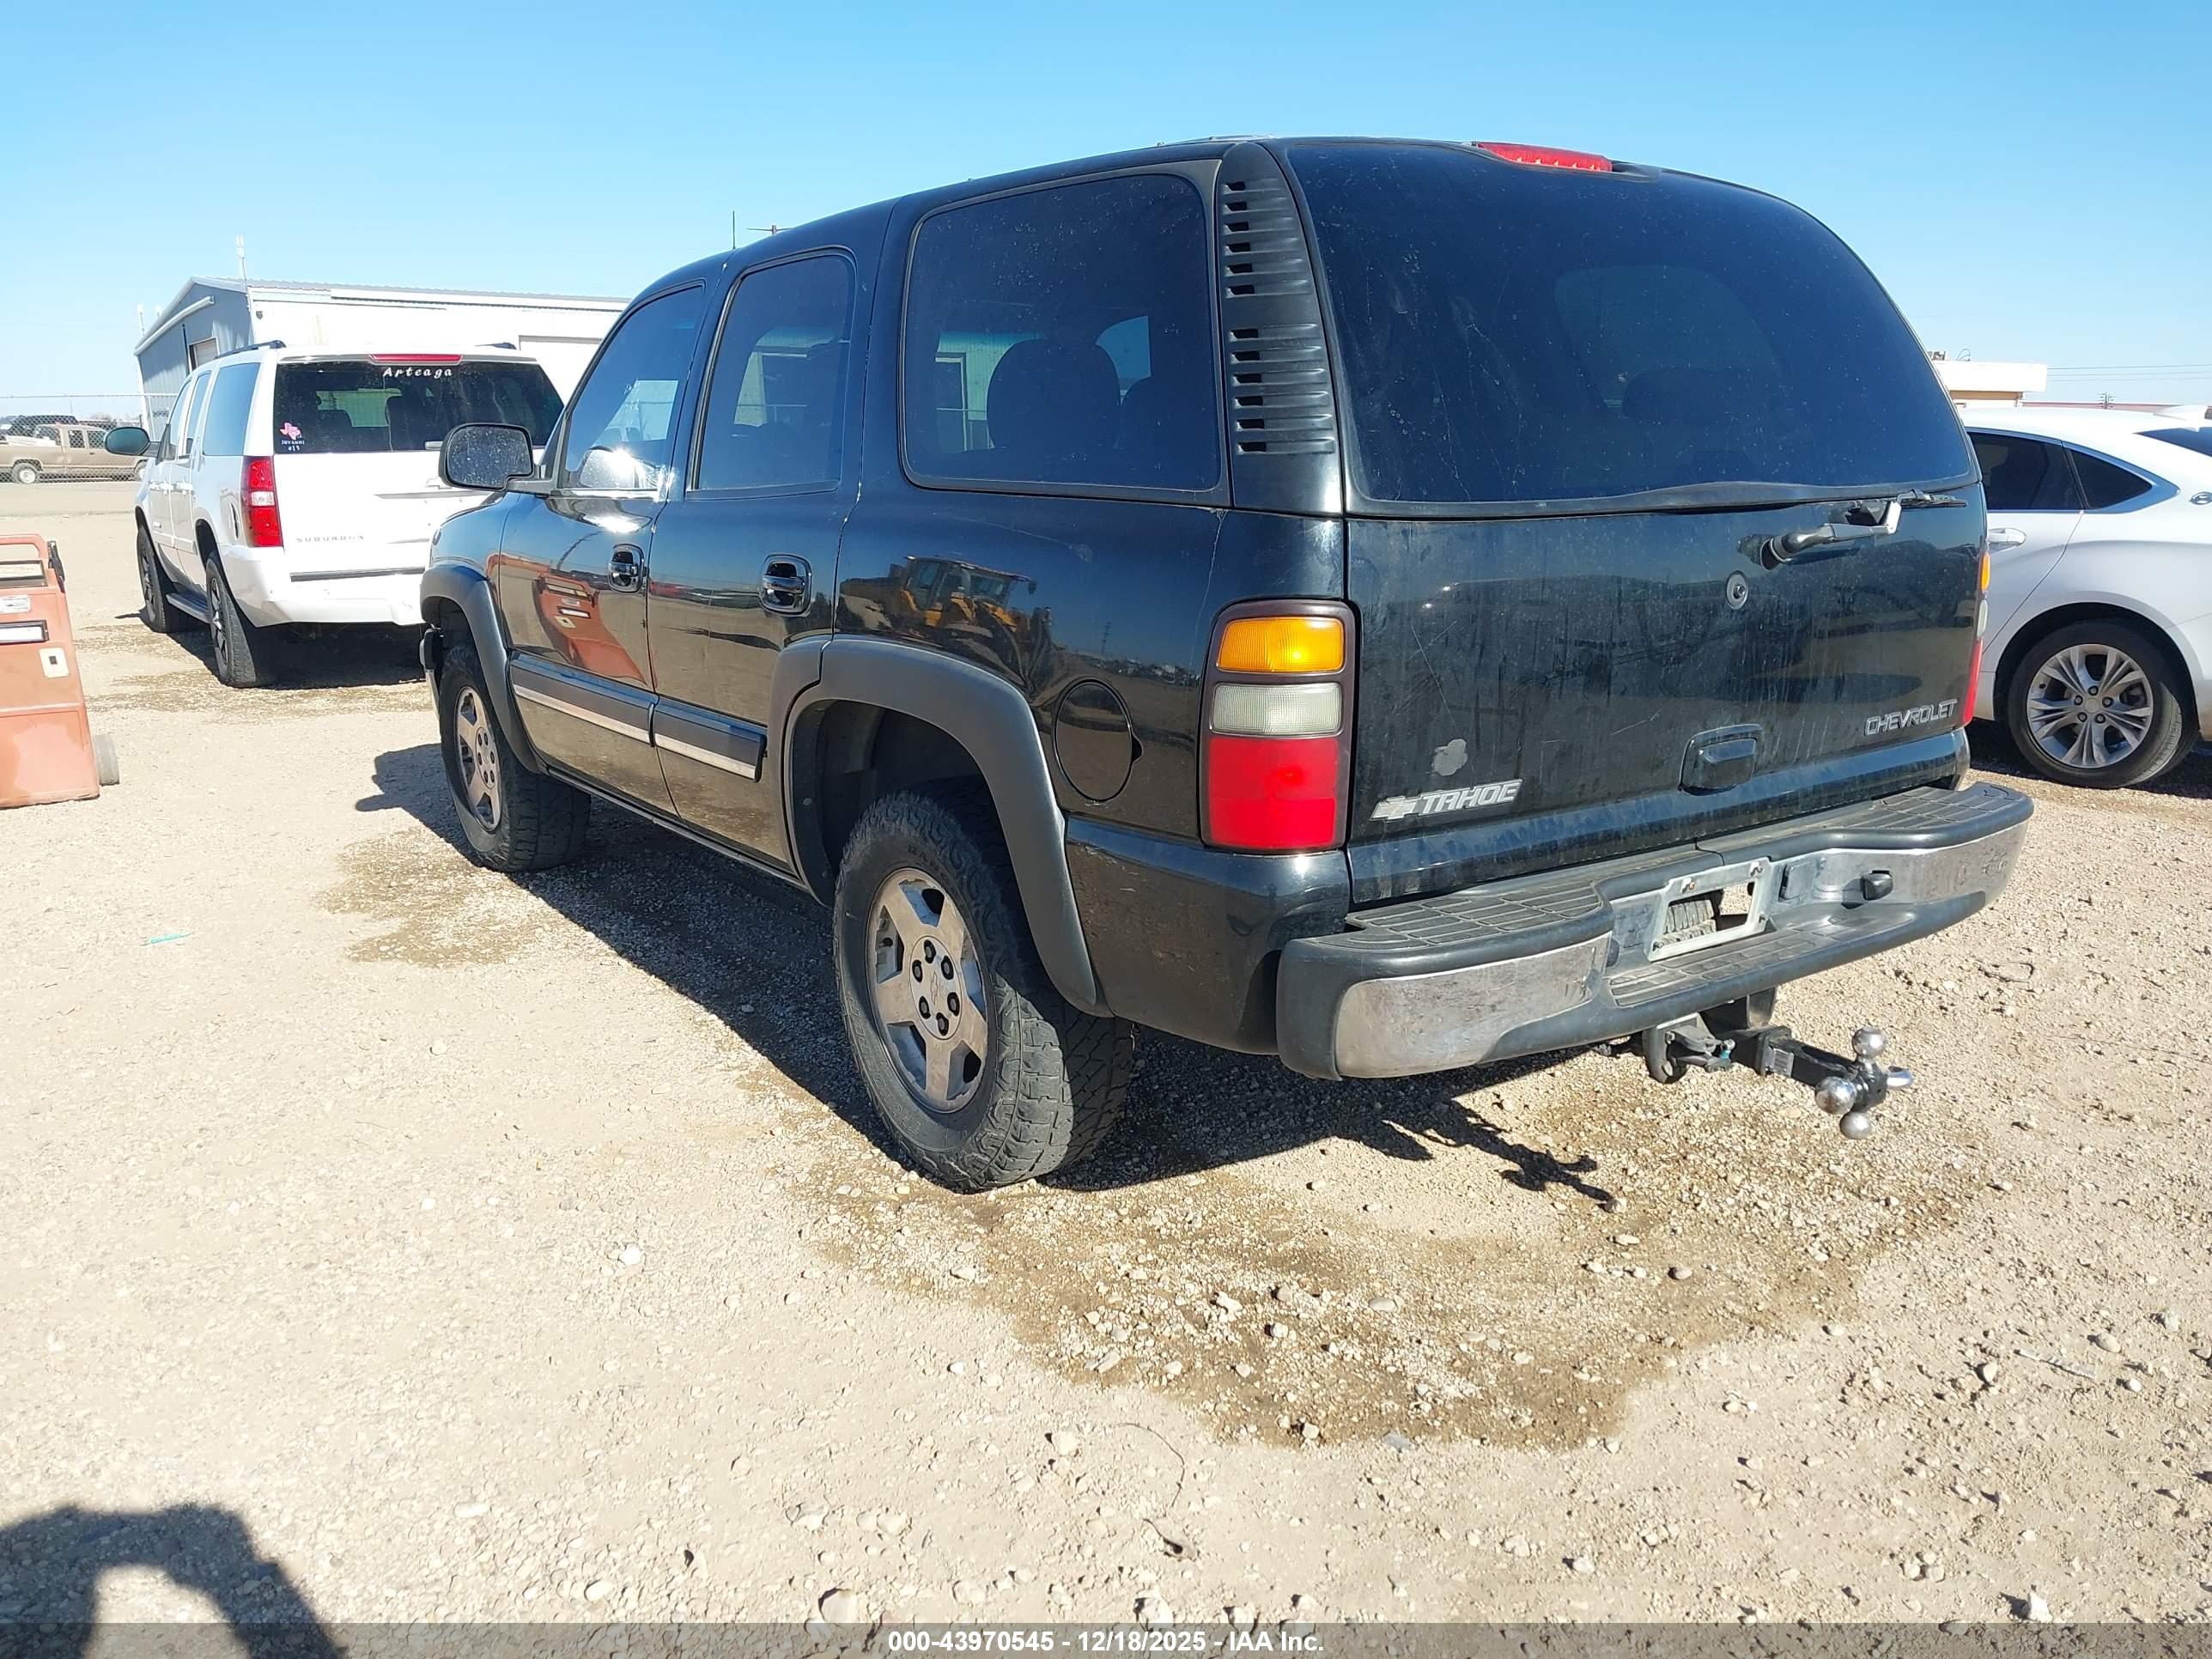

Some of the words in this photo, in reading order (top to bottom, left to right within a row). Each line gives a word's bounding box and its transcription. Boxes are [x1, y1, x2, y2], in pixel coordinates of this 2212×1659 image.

[382, 366, 453, 379] Arteaga
[1865, 698, 1958, 736] CHEVROLET
[1419, 780, 1521, 816] TAHOE
